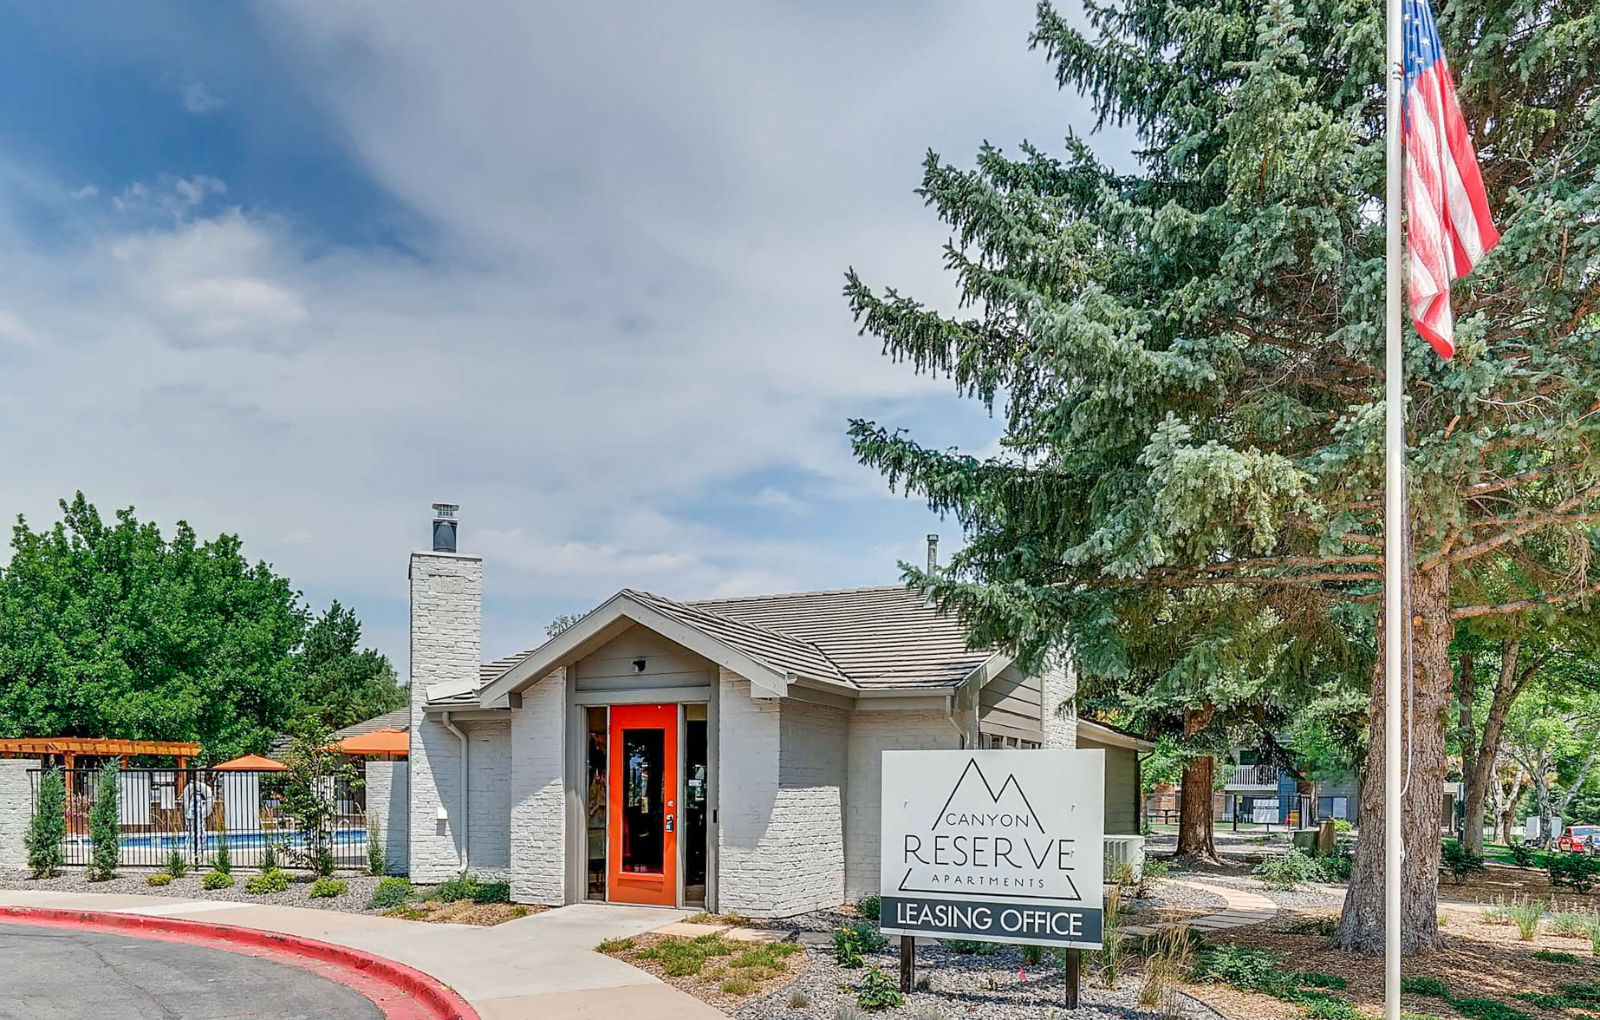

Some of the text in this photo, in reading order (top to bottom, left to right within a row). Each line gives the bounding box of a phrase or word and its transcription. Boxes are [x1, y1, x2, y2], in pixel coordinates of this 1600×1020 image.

[945, 812, 1030, 828] CANYON
[904, 834, 1075, 870] RESERVE
[931, 874, 1045, 888] APARTMENTS
[896, 902, 1083, 936] LEASING OFFICE
